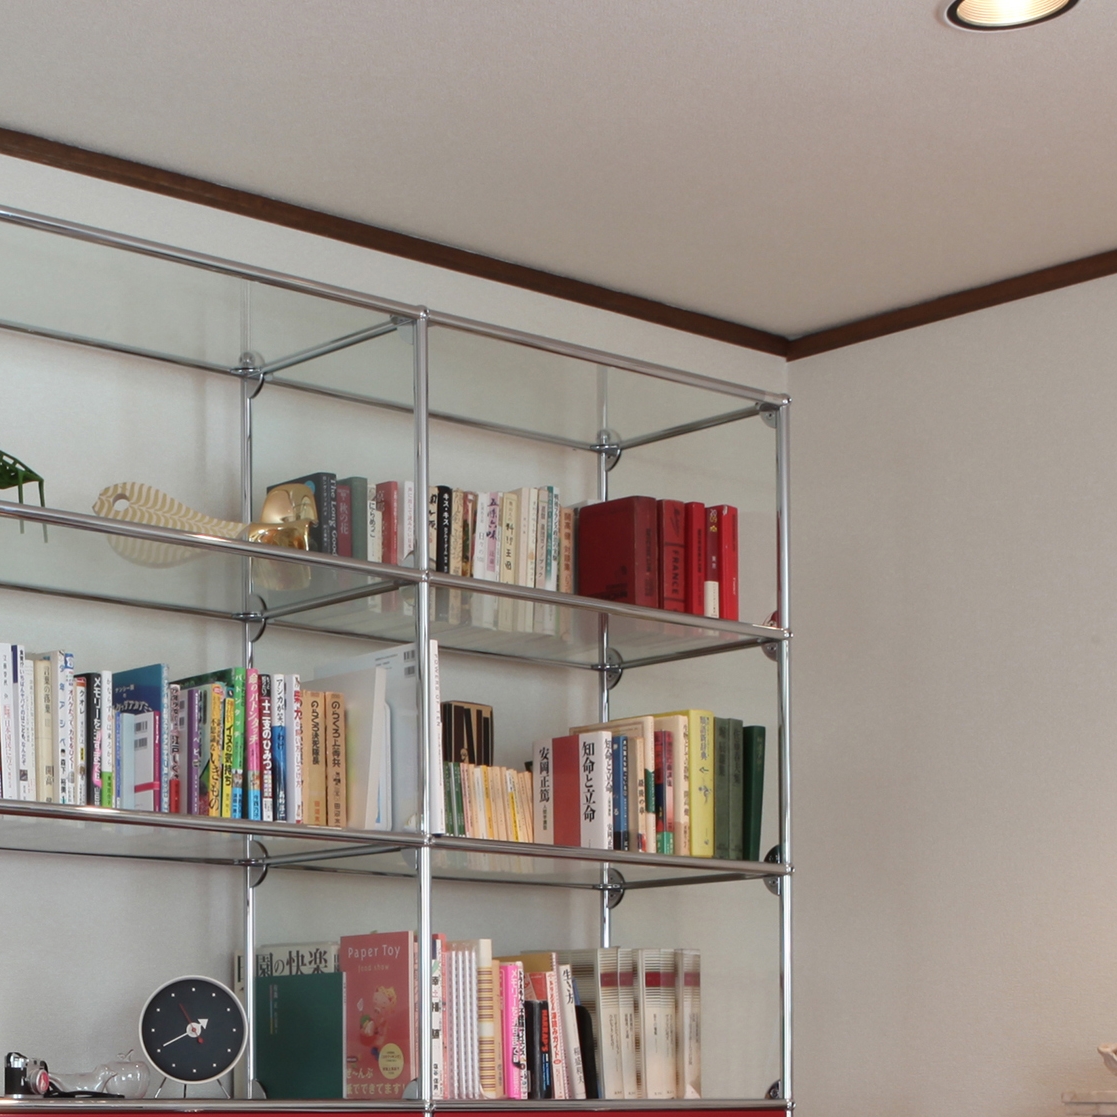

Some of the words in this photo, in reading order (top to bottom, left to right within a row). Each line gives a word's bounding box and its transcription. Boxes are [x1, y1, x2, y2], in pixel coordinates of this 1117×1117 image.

[329, 501, 338, 527] Long
[671, 550, 680, 594] FRANCE
[261, 700, 272, 770] 十二支のひみつ
[539, 747, 550, 803] 安岡正篤
[582, 742, 596, 823] 知命と立命
[348, 947, 378, 961] Paper
[382, 944, 401, 959] Toy
